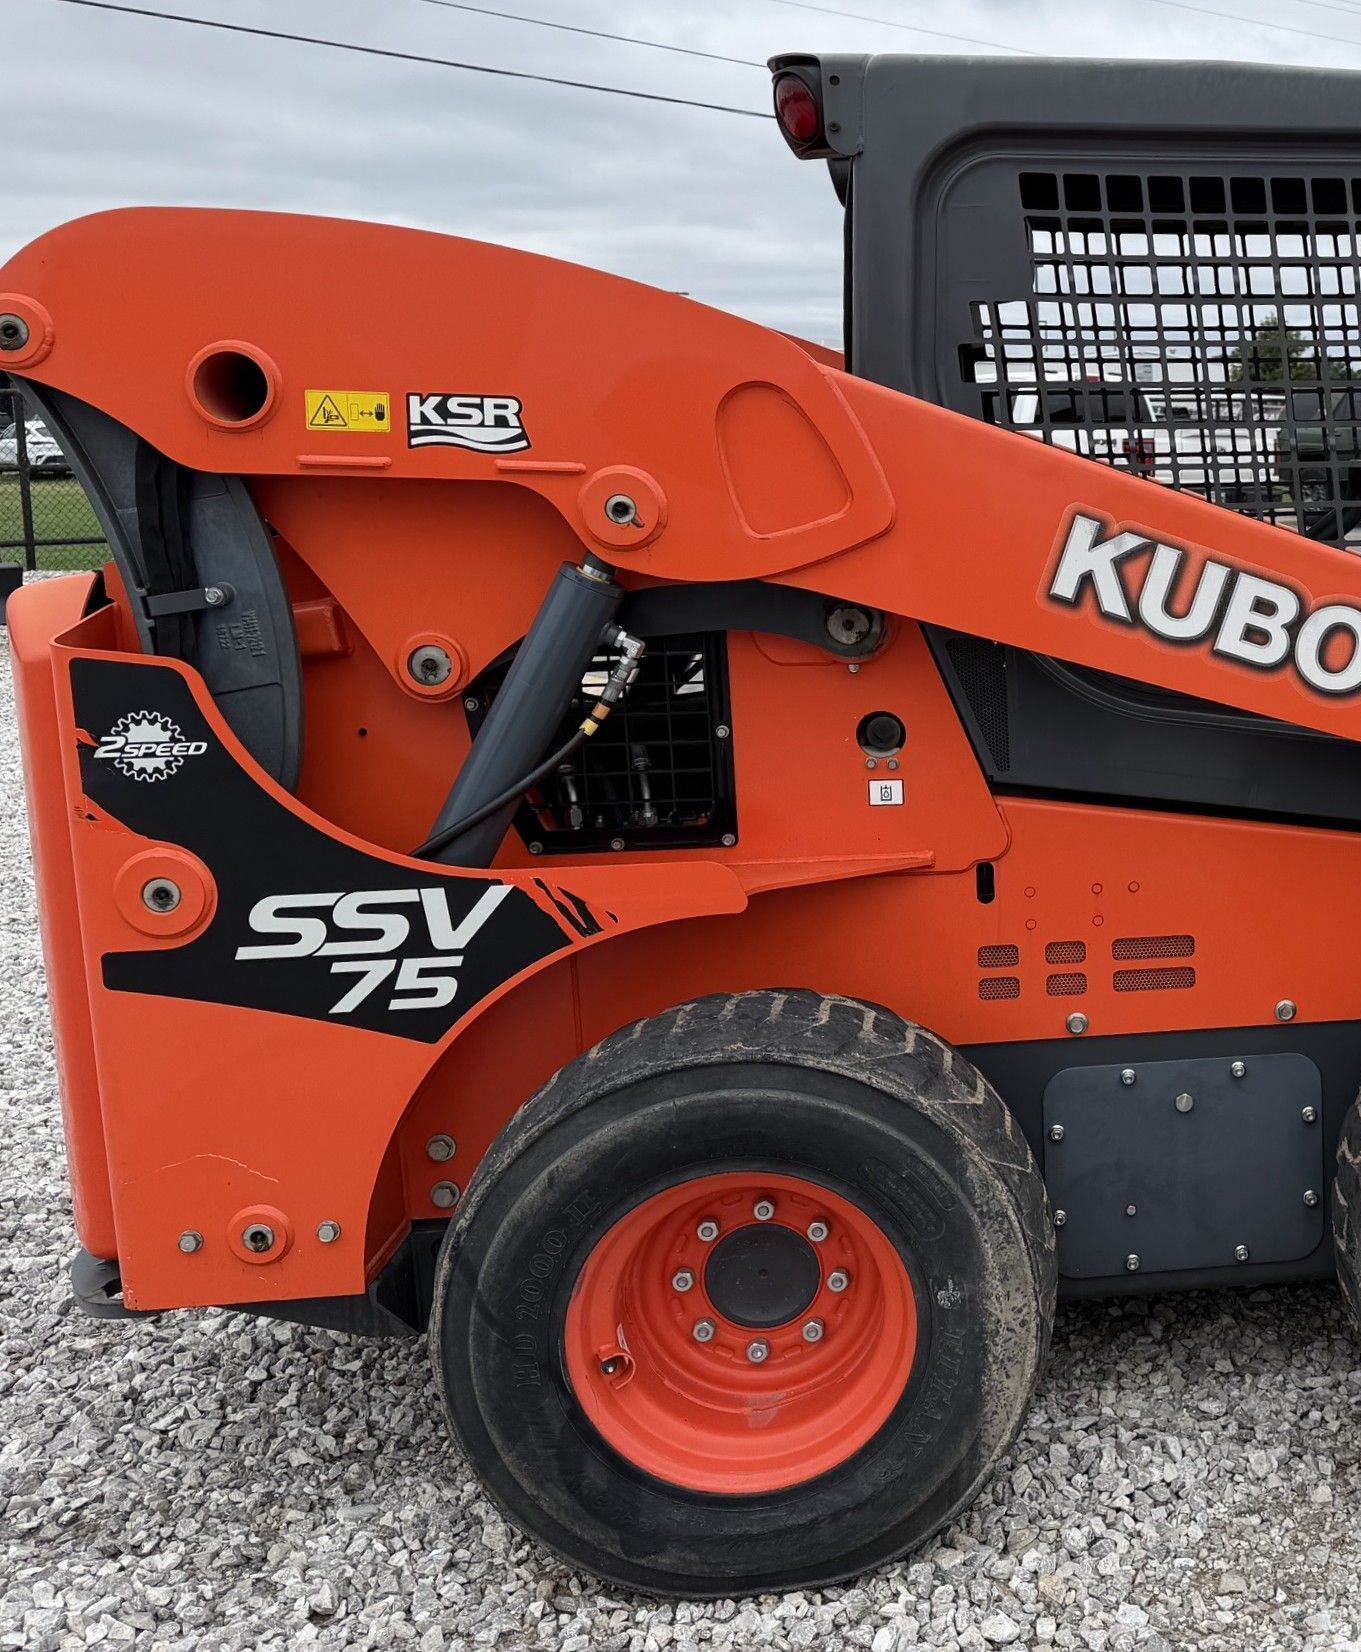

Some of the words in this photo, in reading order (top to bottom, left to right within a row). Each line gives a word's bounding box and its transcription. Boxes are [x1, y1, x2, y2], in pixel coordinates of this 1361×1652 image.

[409, 395, 521, 427] KSR
[234, 884, 515, 961] SSV
[328, 955, 464, 1014] 75
[514, 1229, 568, 1320] 2000
[511, 1333, 542, 1388] HD
